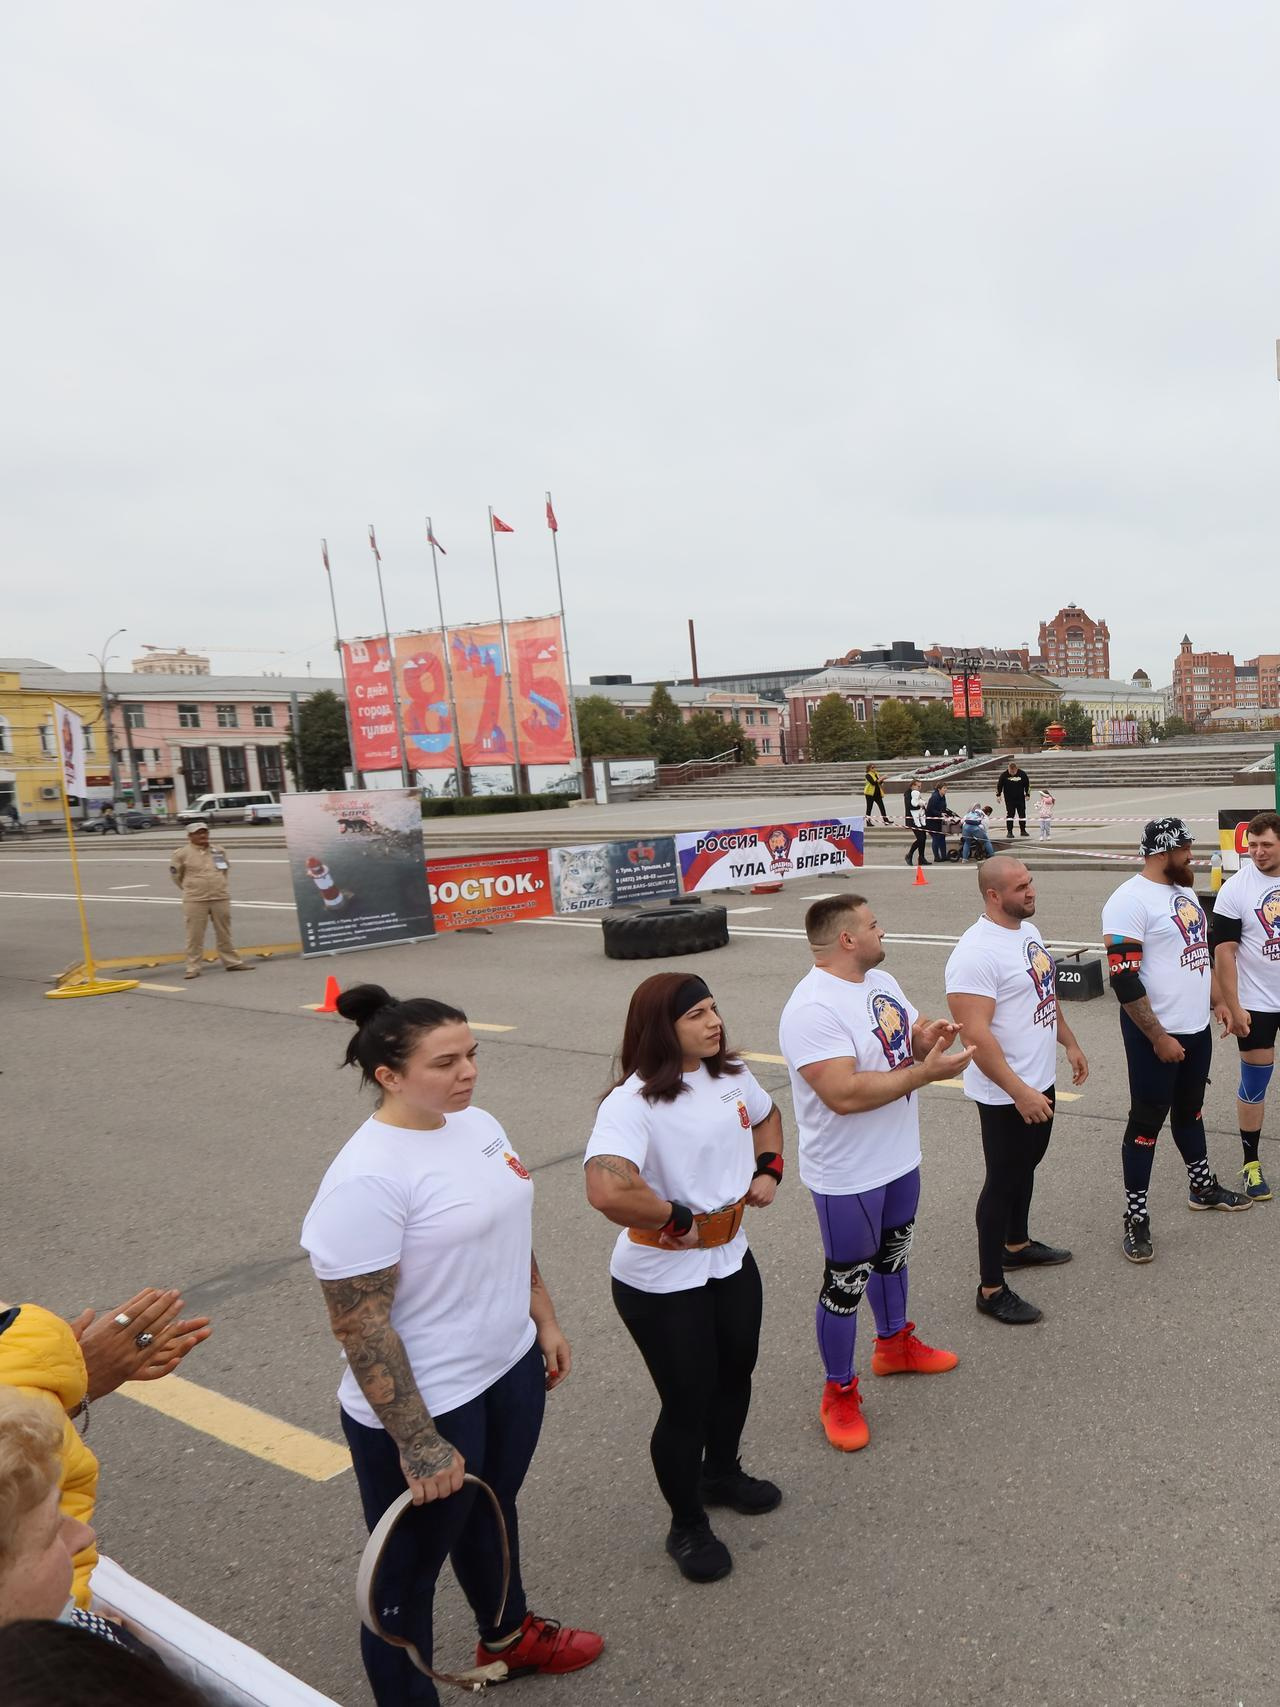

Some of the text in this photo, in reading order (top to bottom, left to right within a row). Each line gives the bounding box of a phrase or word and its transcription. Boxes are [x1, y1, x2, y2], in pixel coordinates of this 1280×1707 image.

[696, 824, 851, 853] РОССИЯ ВПЕРЕД!
[729, 851, 846, 878] ТУЛА ВПЕРЕД!
[1059, 971, 1081, 983] 220
